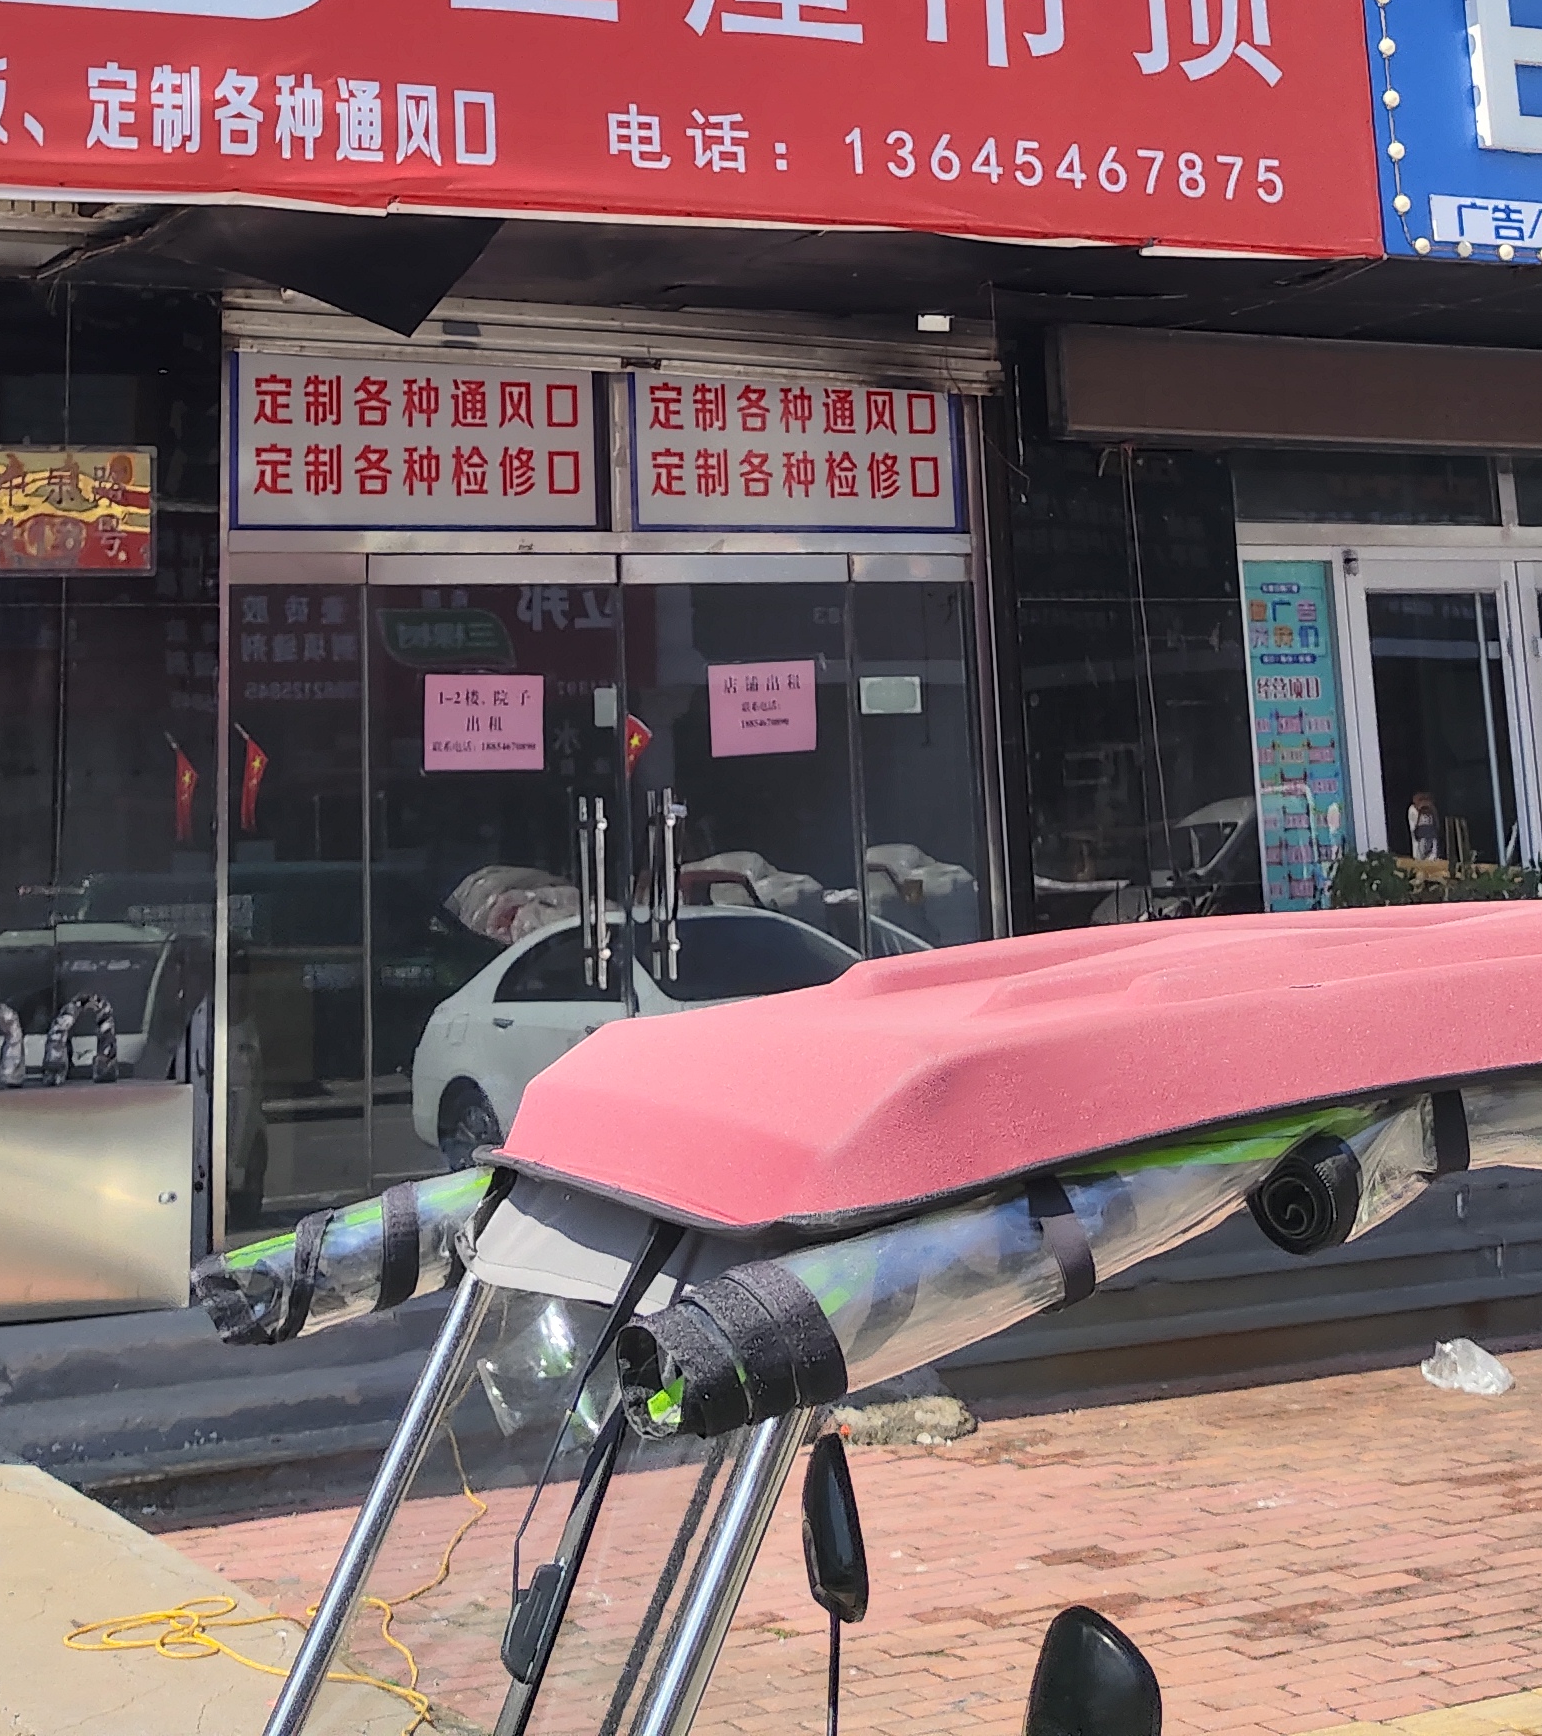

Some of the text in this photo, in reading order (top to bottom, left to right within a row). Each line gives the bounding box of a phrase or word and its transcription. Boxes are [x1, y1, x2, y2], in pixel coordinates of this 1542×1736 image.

[253, 373, 579, 429] 定制各种通风口
[649, 381, 936, 436] 定制各种通风口
[253, 443, 581, 497] 定制各种检修口
[650, 448, 940, 499] 定制各种检修口
